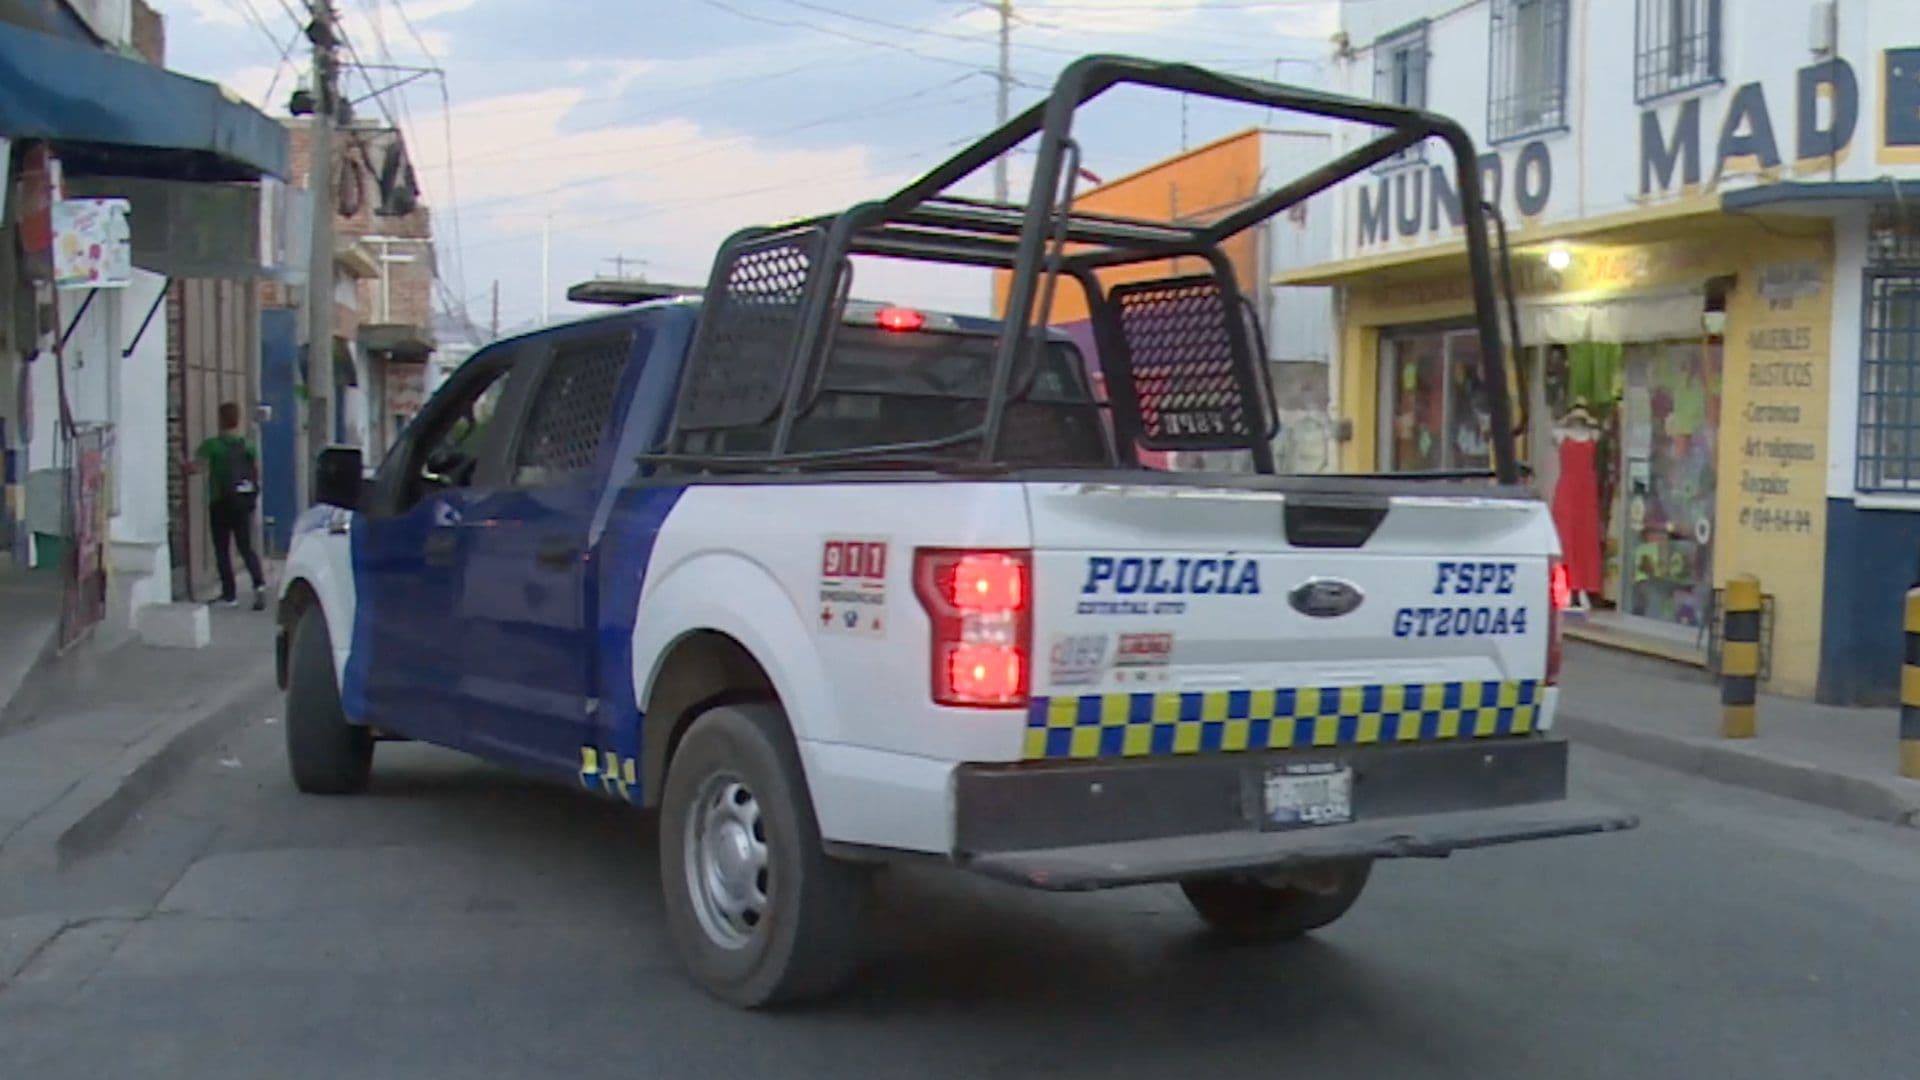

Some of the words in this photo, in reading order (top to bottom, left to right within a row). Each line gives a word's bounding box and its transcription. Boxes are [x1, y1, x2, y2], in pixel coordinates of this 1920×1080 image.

[825, 546, 882, 573] 911
[1082, 551, 1261, 594] POLICÍA
[1433, 562, 1516, 594] FSPE
[1394, 607, 1527, 637] GT200A4
